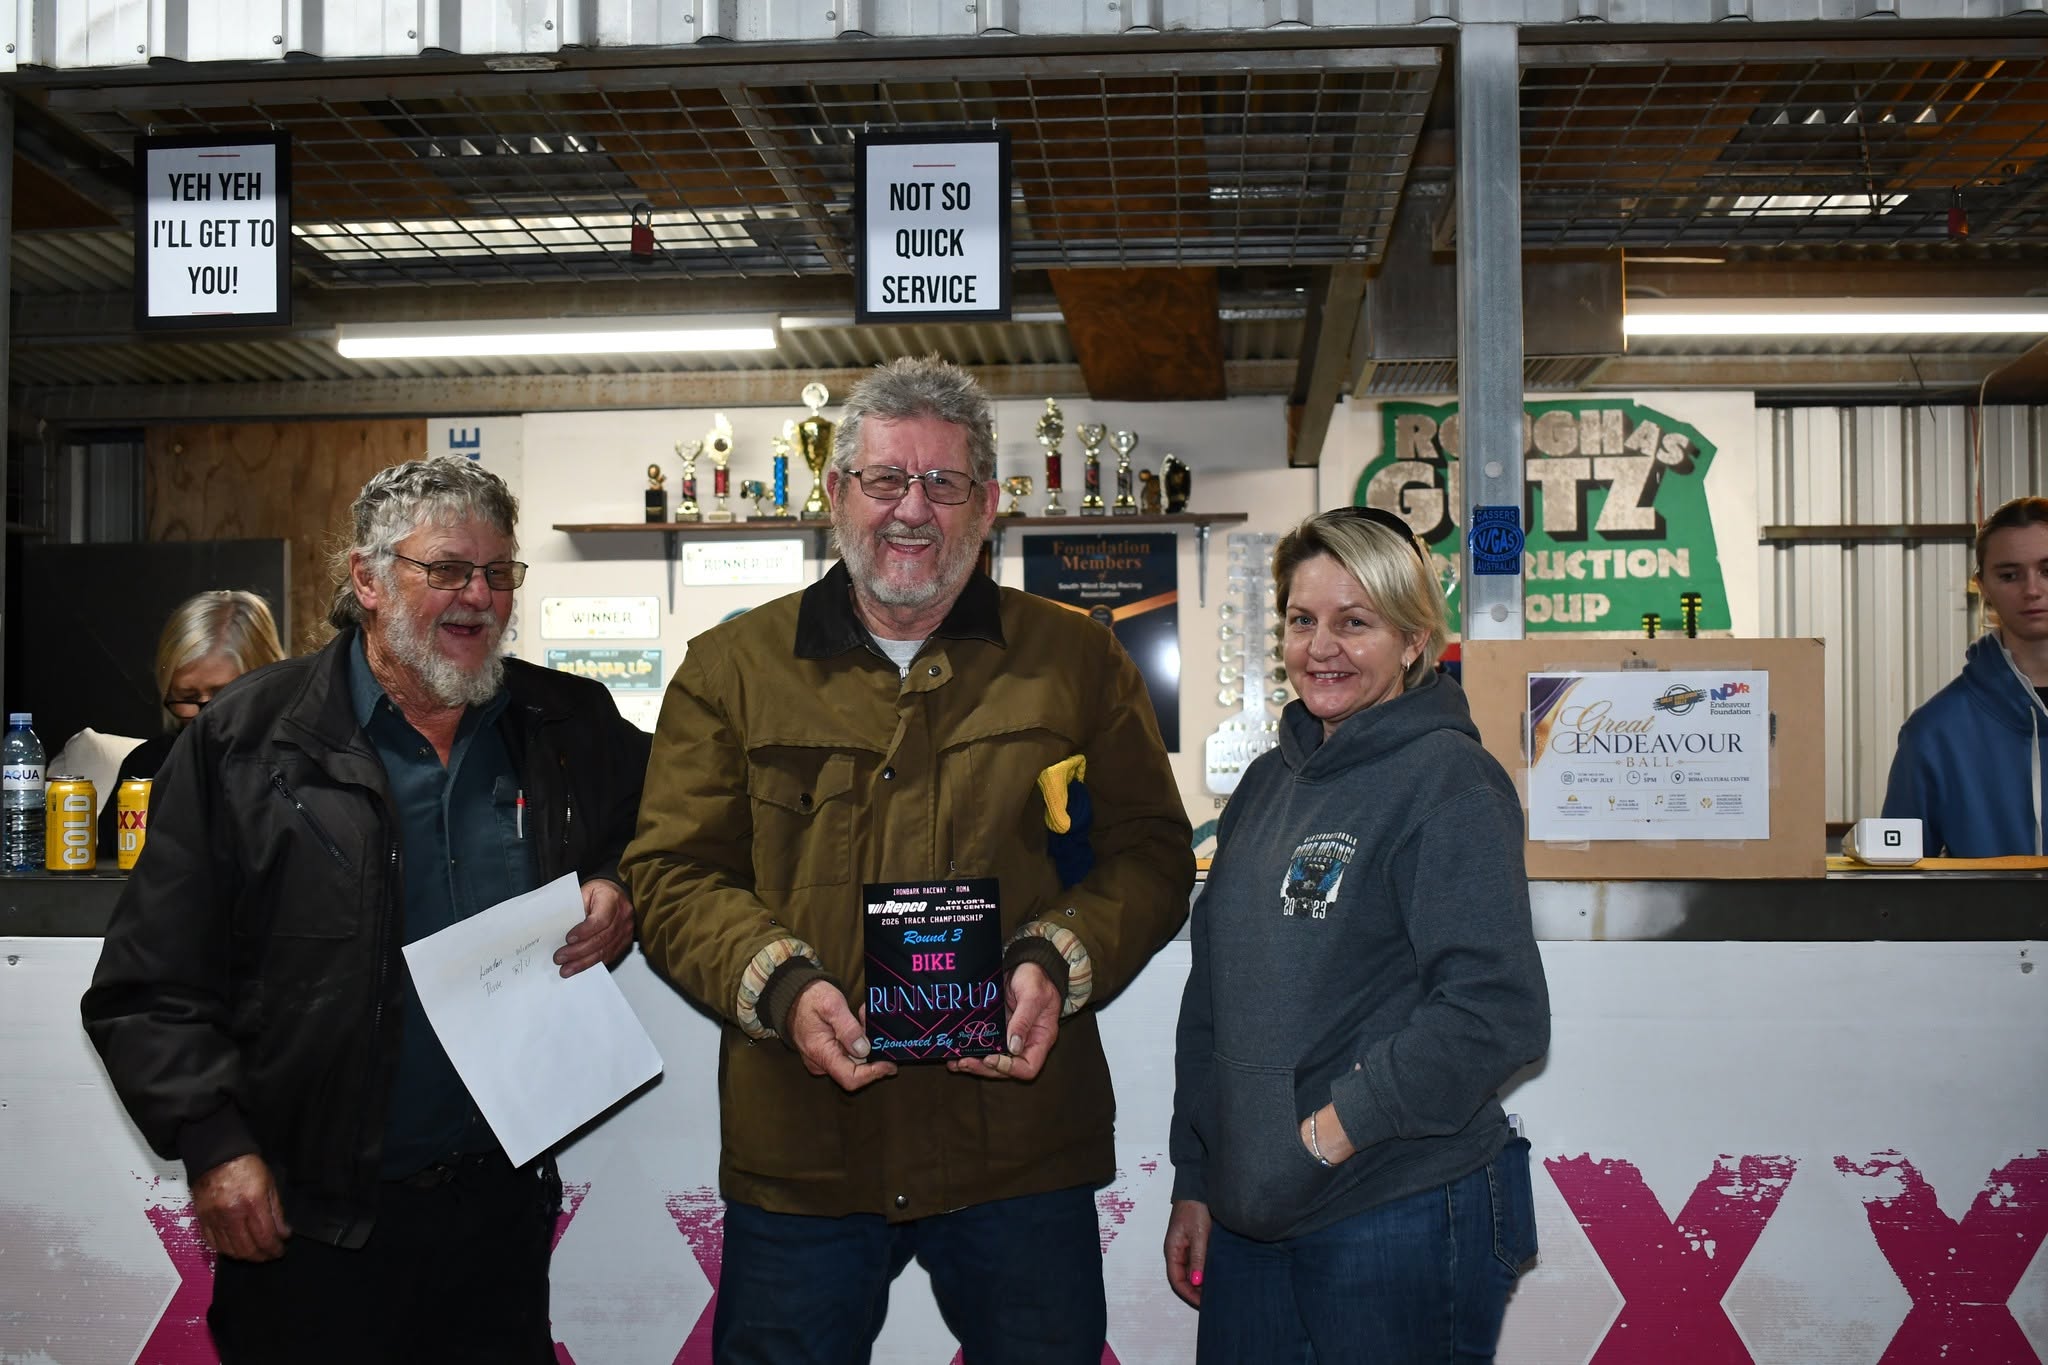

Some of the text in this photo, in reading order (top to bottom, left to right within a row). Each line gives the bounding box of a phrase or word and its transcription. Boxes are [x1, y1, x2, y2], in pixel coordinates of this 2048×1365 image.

[168, 172, 261, 201] YEH YEH
[890, 182, 970, 211] NOT SO
[154, 219, 275, 247] I'LL GET TO
[896, 229, 964, 259] QUICK
[188, 266, 238, 294] YOU!
[882, 275, 977, 304] SERVICE
[1395, 410, 1625, 458] RGH
[1366, 456, 1656, 536] GTZ
[1476, 510, 1516, 522] GASSERS
[1052, 541, 1151, 556] Foundation
[1478, 527, 1515, 553] V/GAS
[1061, 555, 1143, 570] Members
[1476, 559, 1517, 573] AUSTRALIA
[1058, 582, 1080, 590] South
[1117, 581, 1143, 591] Racing
[1080, 590, 1121, 598] Association
[1525, 593, 1610, 622] OUP
[572, 612, 632, 624] WINNER
[1560, 700, 1655, 735] Great
[1575, 733, 1744, 754] ENDEAVOUR
[1626, 756, 1673, 768] BALL
[4, 769, 40, 781] AQUA
[63, 794, 91, 865] GOLD
[119, 810, 147, 830] XX
[893, 885, 970, 896] IRONBARK RACEWAY ROMA
[882, 900, 928, 915] Repco
[1283, 897, 1328, 919] 20 23
[881, 913, 984, 926] 2026 TRACK CHAMPIONSHIP
[903, 928, 963, 945] Round 3
[911, 953, 956, 972] BIKE
[869, 981, 998, 1013] RUNNER UP
[872, 1035, 932, 1051] Sponsored
[936, 1033, 954, 1049] By
